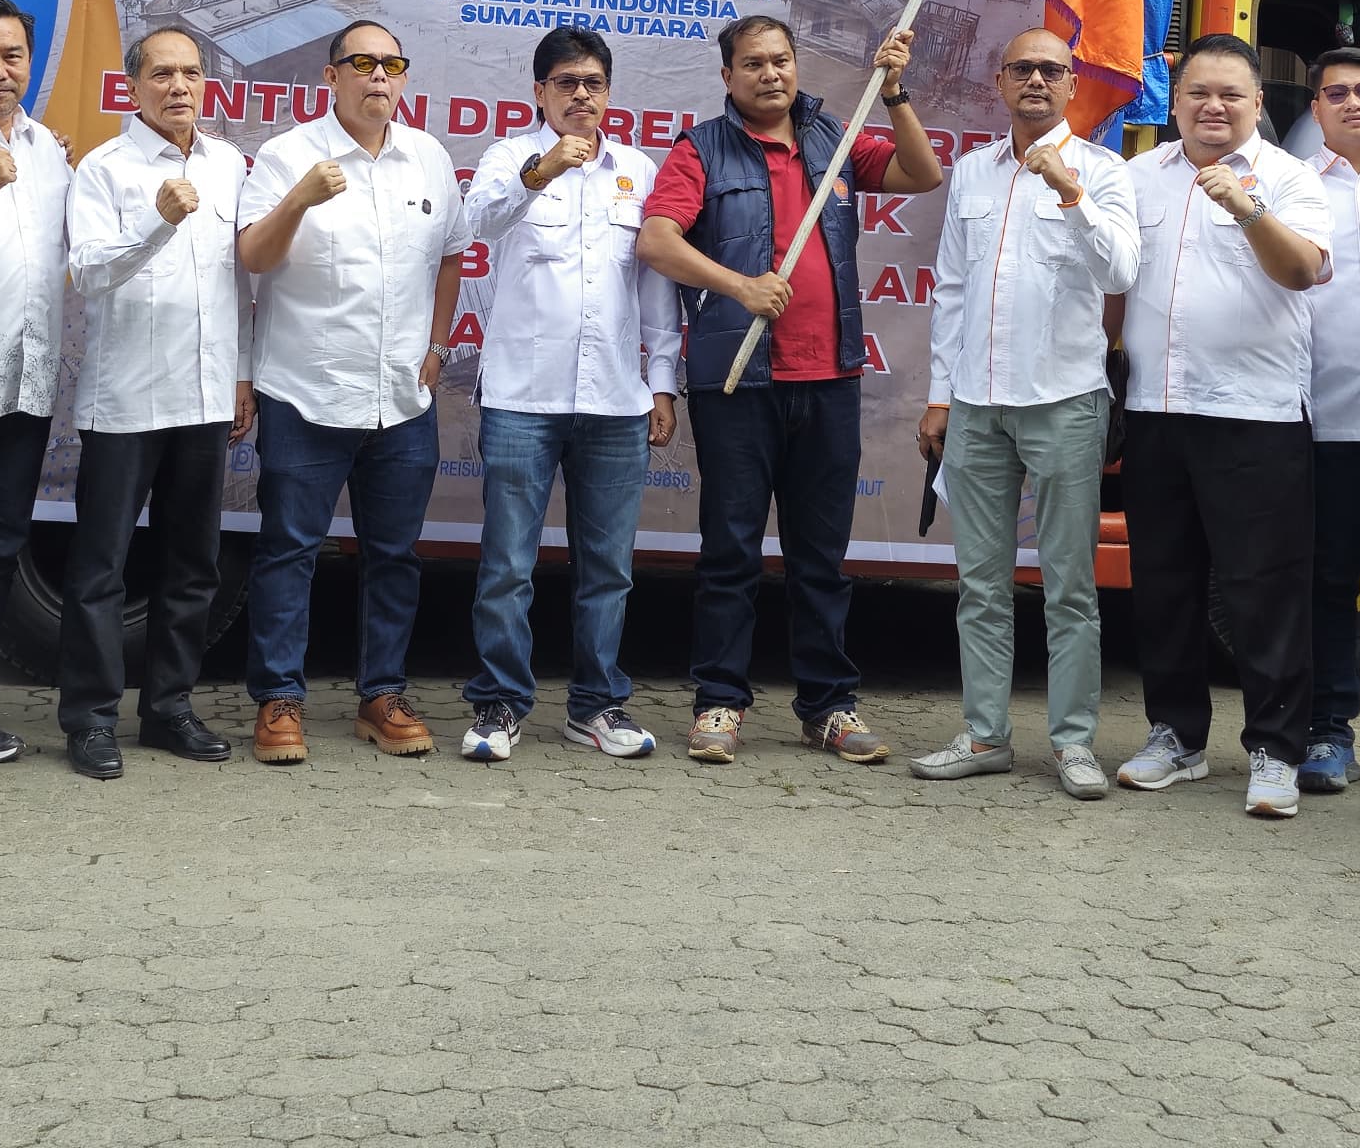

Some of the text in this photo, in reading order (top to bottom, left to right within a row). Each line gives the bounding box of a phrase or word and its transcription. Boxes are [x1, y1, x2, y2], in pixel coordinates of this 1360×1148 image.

[461, 4, 709, 42] SUMATERA UTARA
[100, 70, 428, 132] BNTUN
[447, 95, 535, 137] DP
